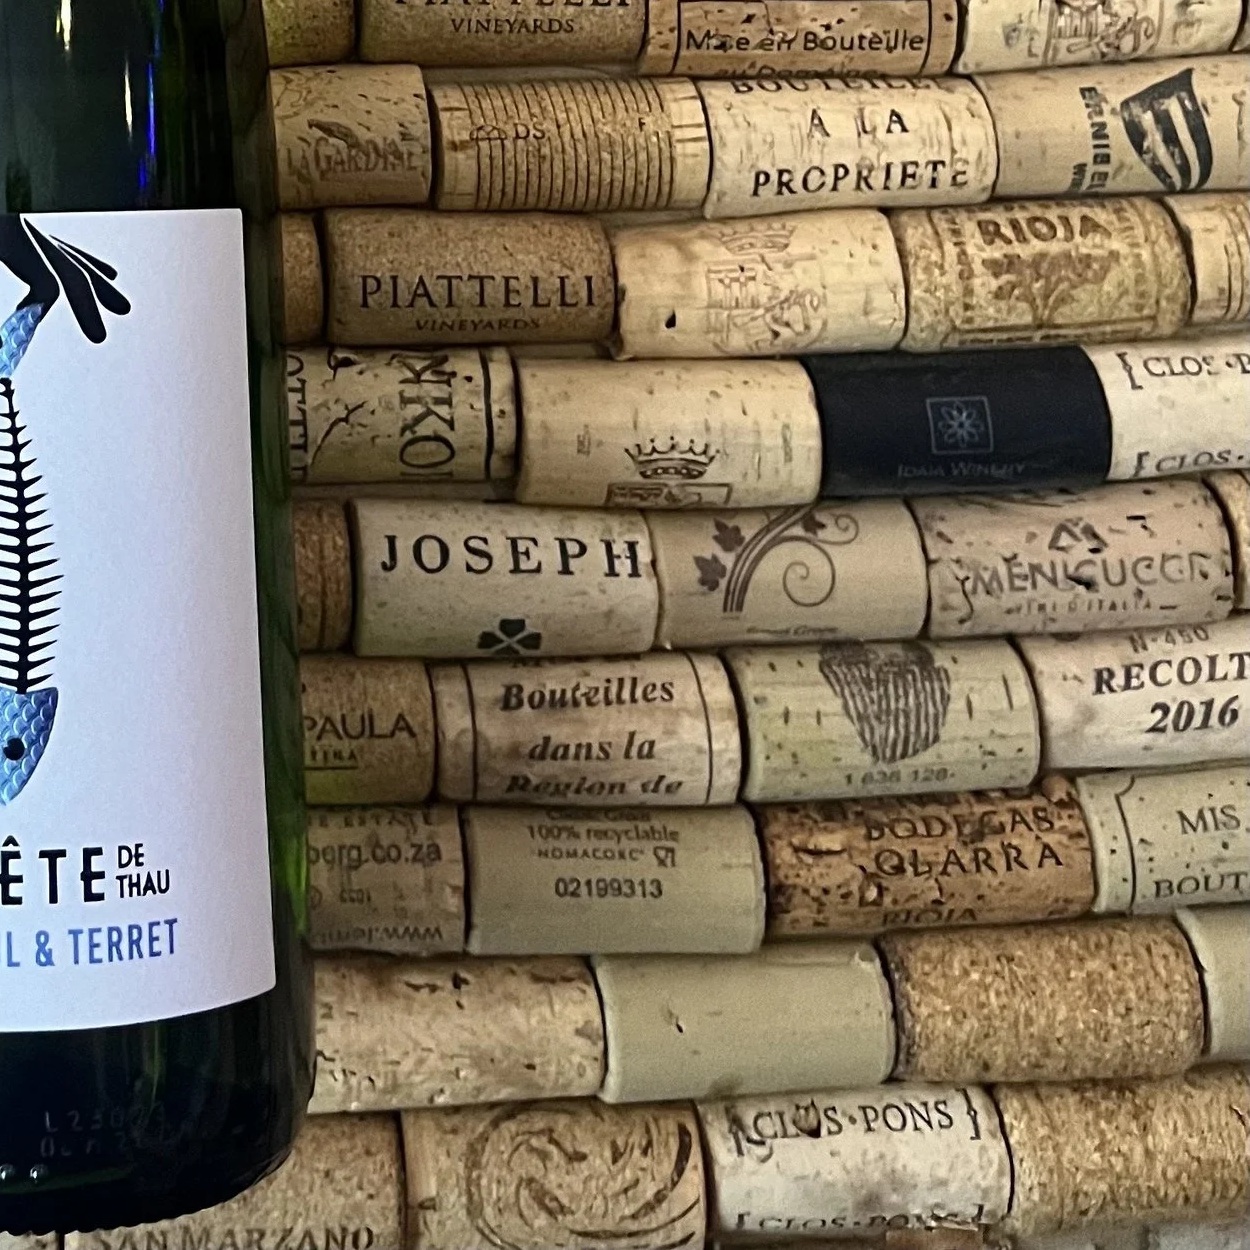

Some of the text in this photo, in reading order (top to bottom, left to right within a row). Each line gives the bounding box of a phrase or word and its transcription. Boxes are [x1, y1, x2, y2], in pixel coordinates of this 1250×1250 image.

[450, 16, 575, 36] VINEYARDS
[803, 30, 926, 54] Bouteille
[751, 158, 971, 198] PROPRIETE
[977, 215, 1113, 246] RIOJA
[360, 274, 597, 310] PIATTELLI
[416, 317, 542, 332] VINEYARDS
[380, 534, 642, 579] JOSEPH
[500, 677, 676, 713] Bouteilles
[1144, 694, 1239, 735] 2016
[527, 730, 657, 764] dans la
[117, 842, 146, 869] DE
[115, 868, 171, 899] THAU
[554, 877, 664, 900] 02199313
[34, 931, 55, 968] &
[67, 917, 180, 965] TERRET
